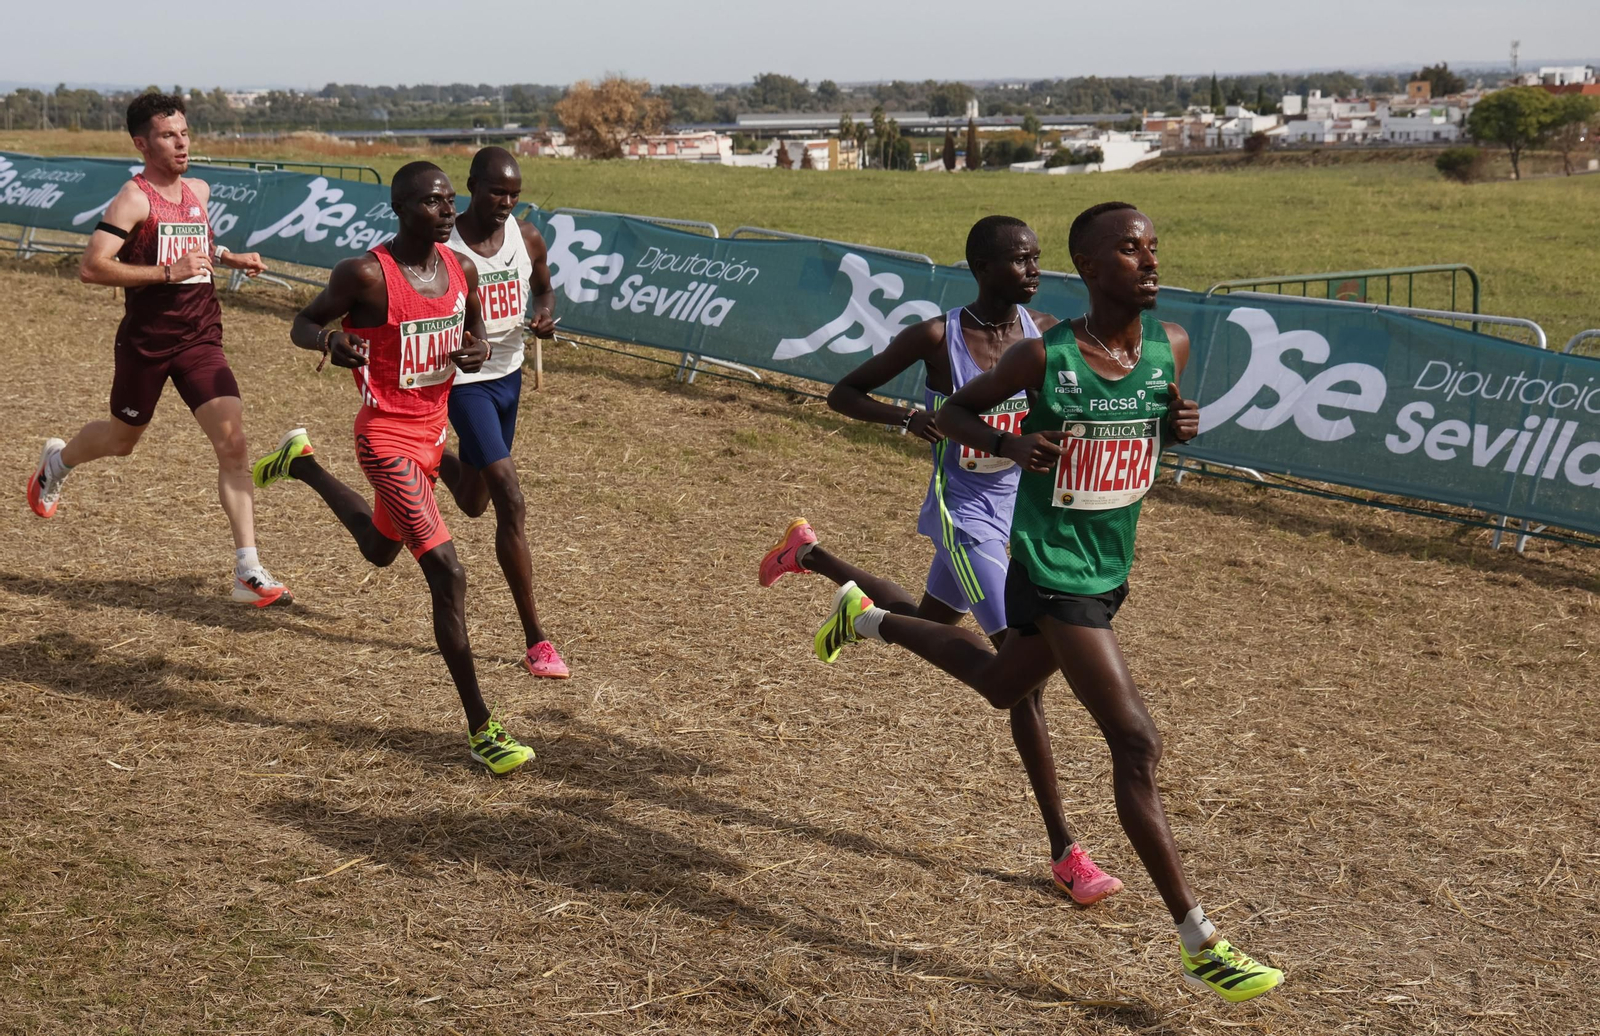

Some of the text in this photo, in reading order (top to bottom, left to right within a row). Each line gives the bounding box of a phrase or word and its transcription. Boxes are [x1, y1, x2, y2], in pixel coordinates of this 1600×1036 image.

[0, 181, 65, 209] Sevilla
[207, 201, 239, 237] lla
[636, 247, 759, 285] Diputación
[610, 274, 736, 328] Sevilla
[1089, 398, 1138, 411] Facsa
[1092, 425, 1137, 437] ITÁLICA
[1057, 438, 1153, 492] KWIZERA
